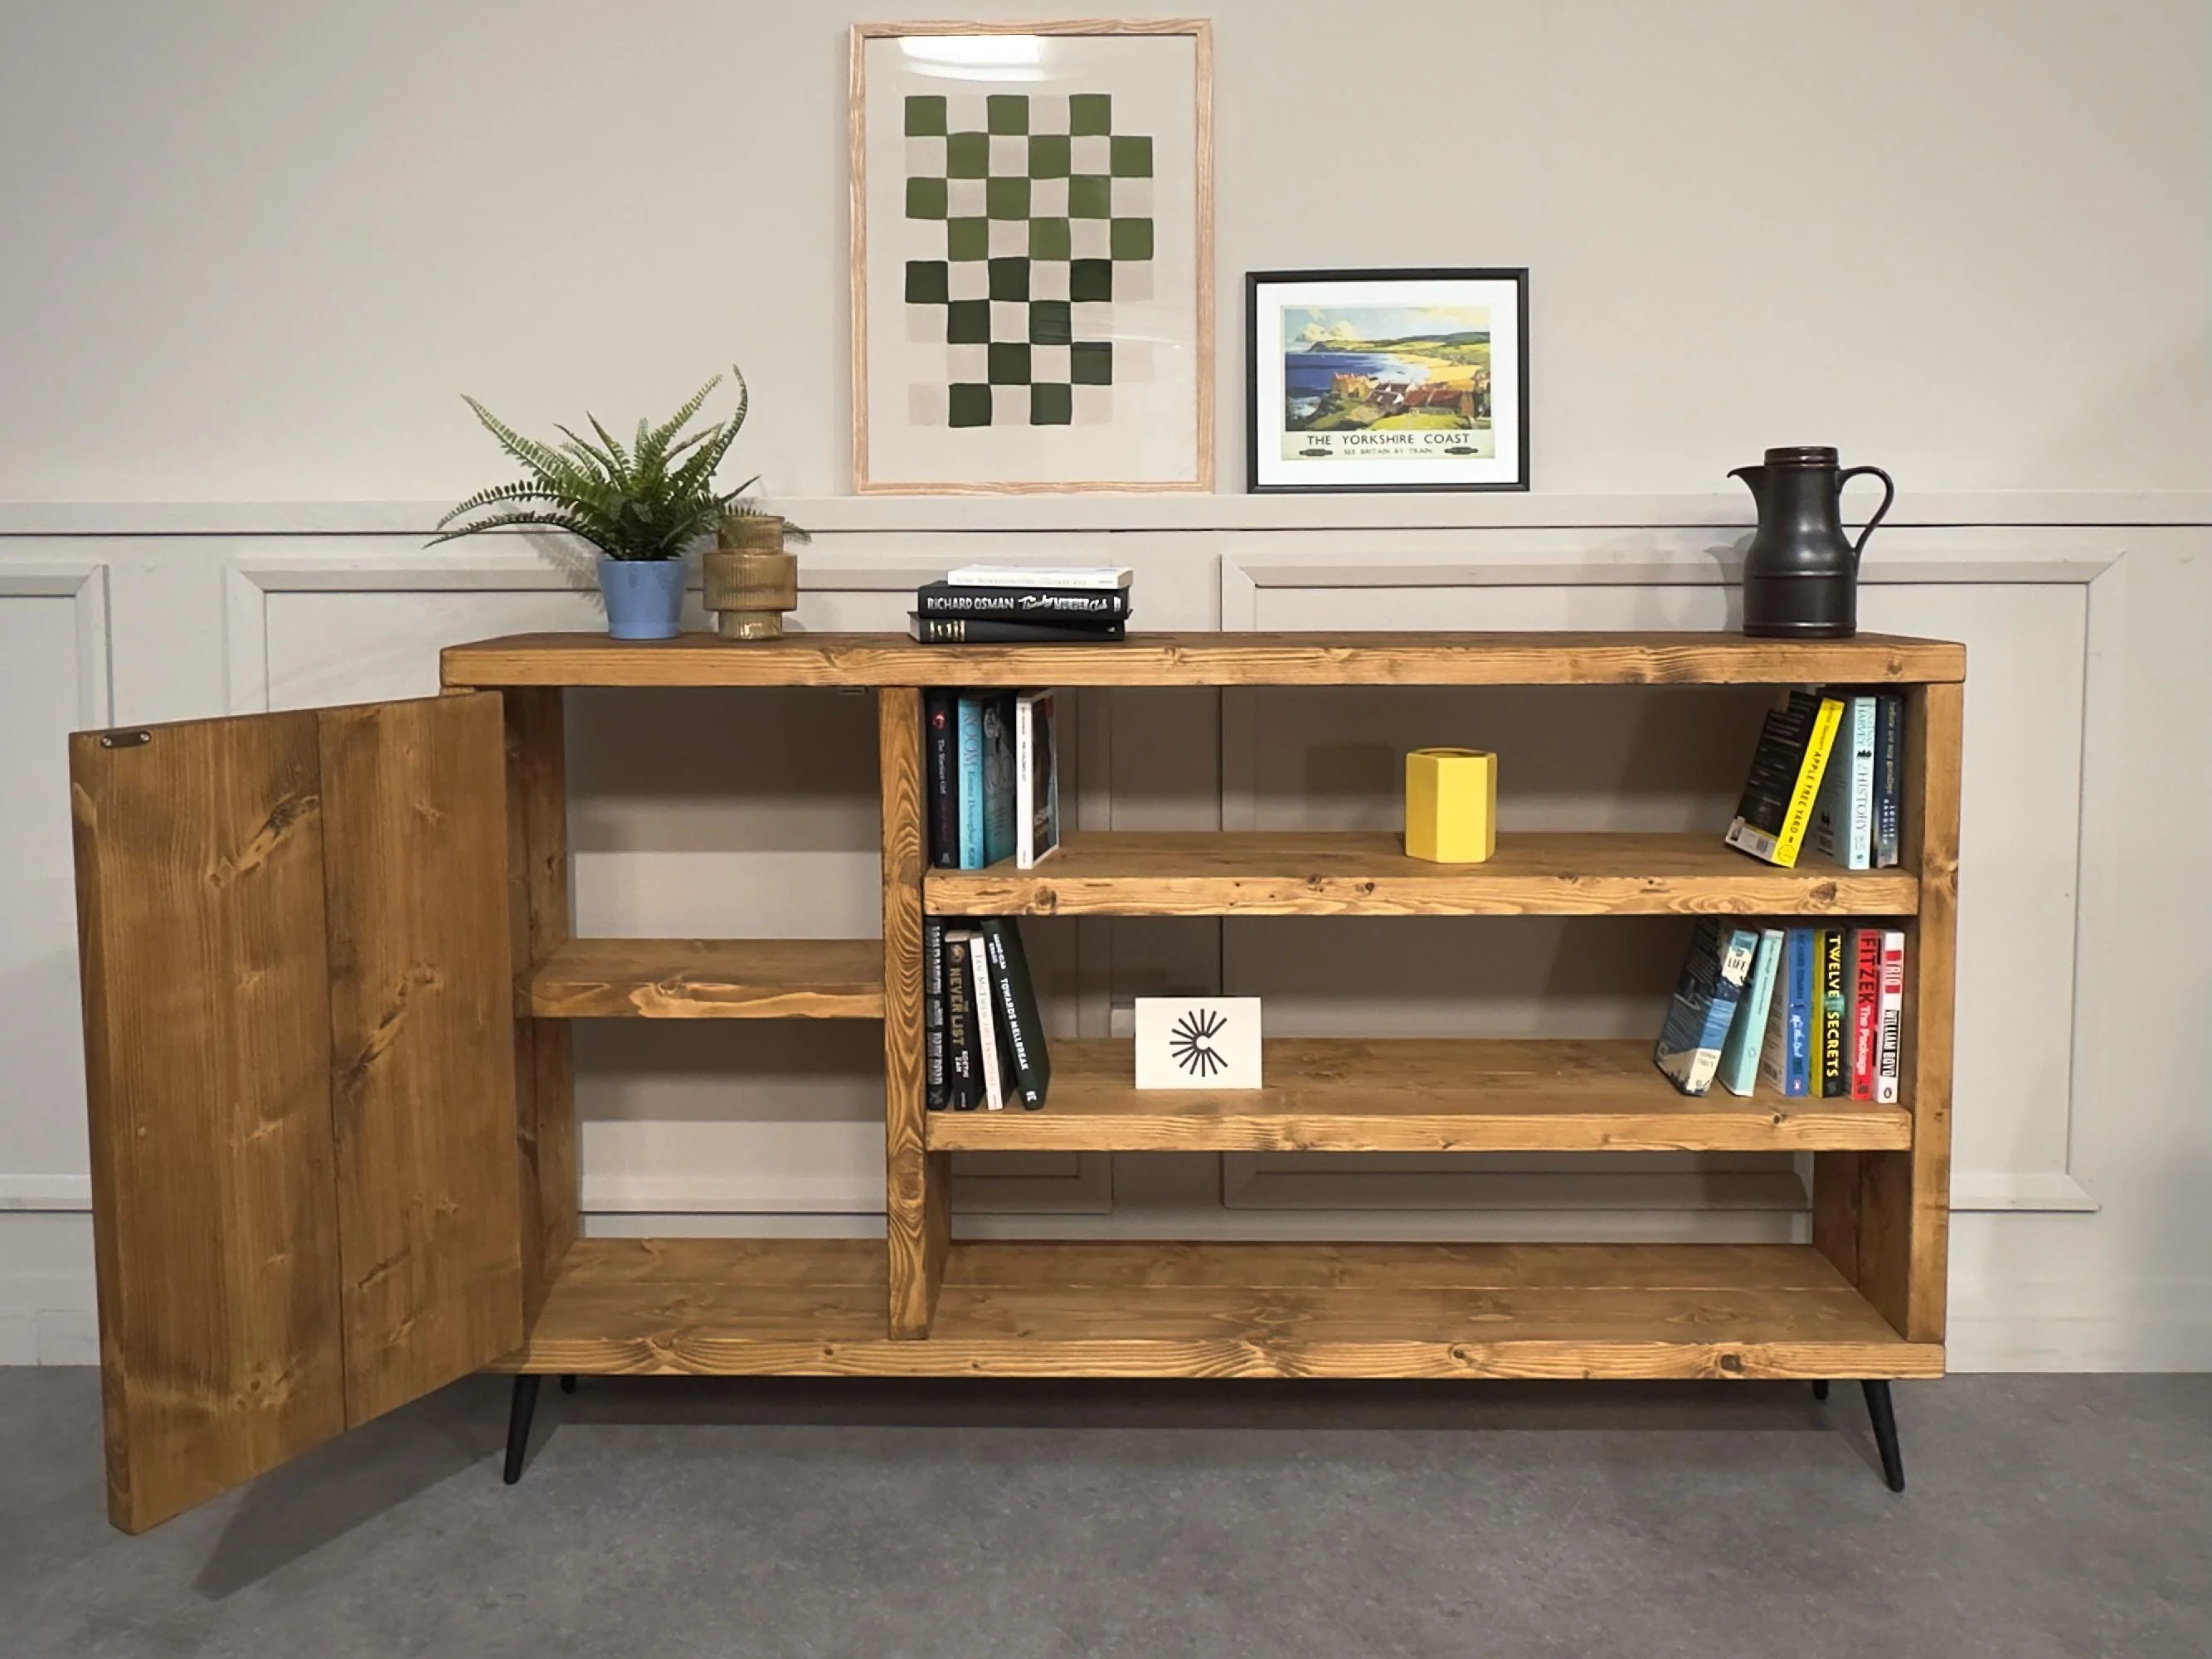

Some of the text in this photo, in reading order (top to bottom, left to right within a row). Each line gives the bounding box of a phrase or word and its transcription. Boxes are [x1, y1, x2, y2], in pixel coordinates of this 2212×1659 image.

[1307, 433, 1471, 445] THE YORKSHIRE COAST
[927, 596, 1015, 611] RICHARD OSMAN
[963, 711, 978, 767] ROOM
[1790, 752, 1823, 834] APPLE TREE YARD
[1855, 771, 1869, 830] HISTORY
[1728, 957, 1746, 971] LIFE
[1858, 937, 1877, 1004] FITZEK
[1884, 961, 1902, 985] TRIO
[949, 966, 965, 1046] NEVER LIST
[1000, 977, 1030, 1071] TOWARDS MELLBREAK
[1826, 934, 1841, 1078] TWELVE SECRETS
[1860, 1005, 1871, 1027] The
[1856, 1028, 1870, 1076] Package
[1881, 1010, 1899, 1078] WILLIAM BOYD
